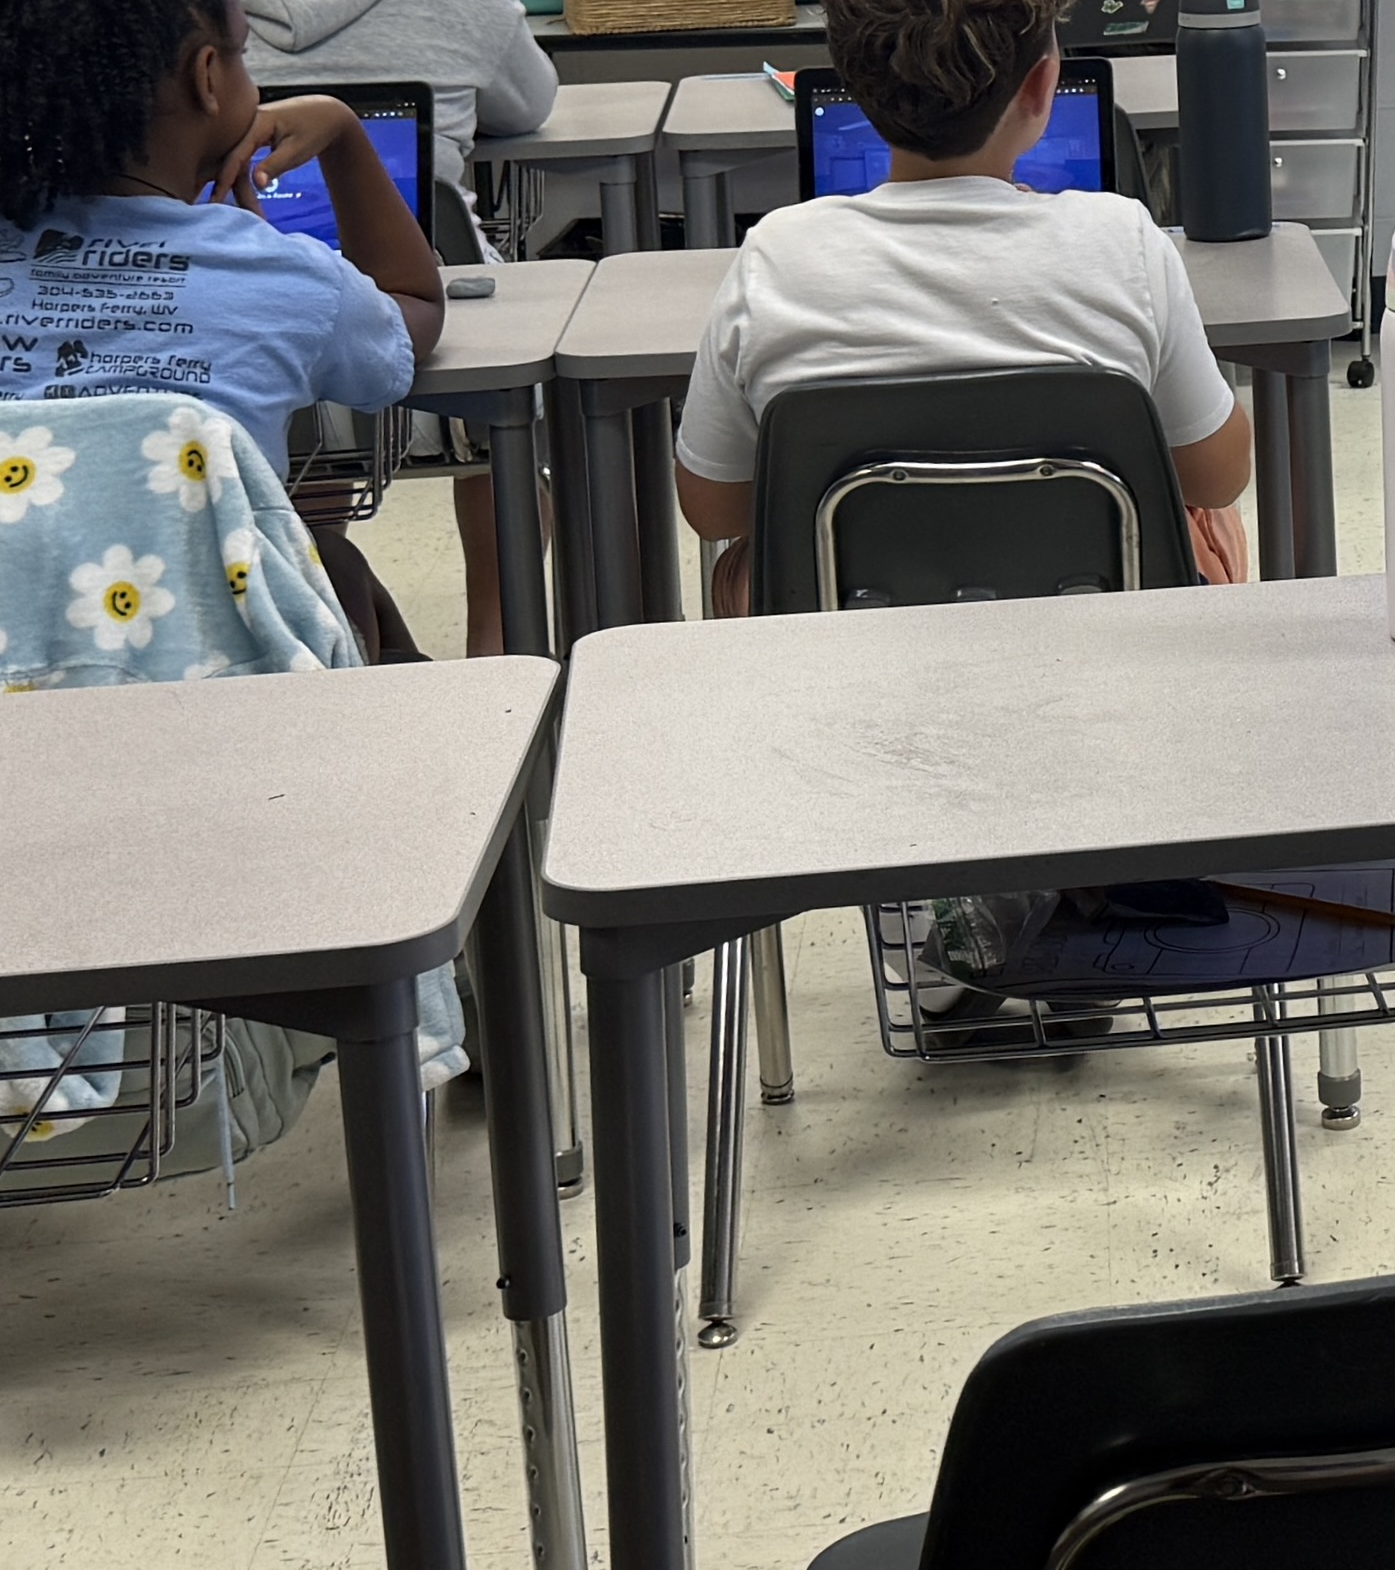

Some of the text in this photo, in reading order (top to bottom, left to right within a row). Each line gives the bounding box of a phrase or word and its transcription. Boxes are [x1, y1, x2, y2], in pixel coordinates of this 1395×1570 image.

[82, 248, 190, 272] riders
[31, 299, 96, 313] Harpers
[151, 304, 179, 316] WV
[90, 352, 212, 371] harpers ferry
